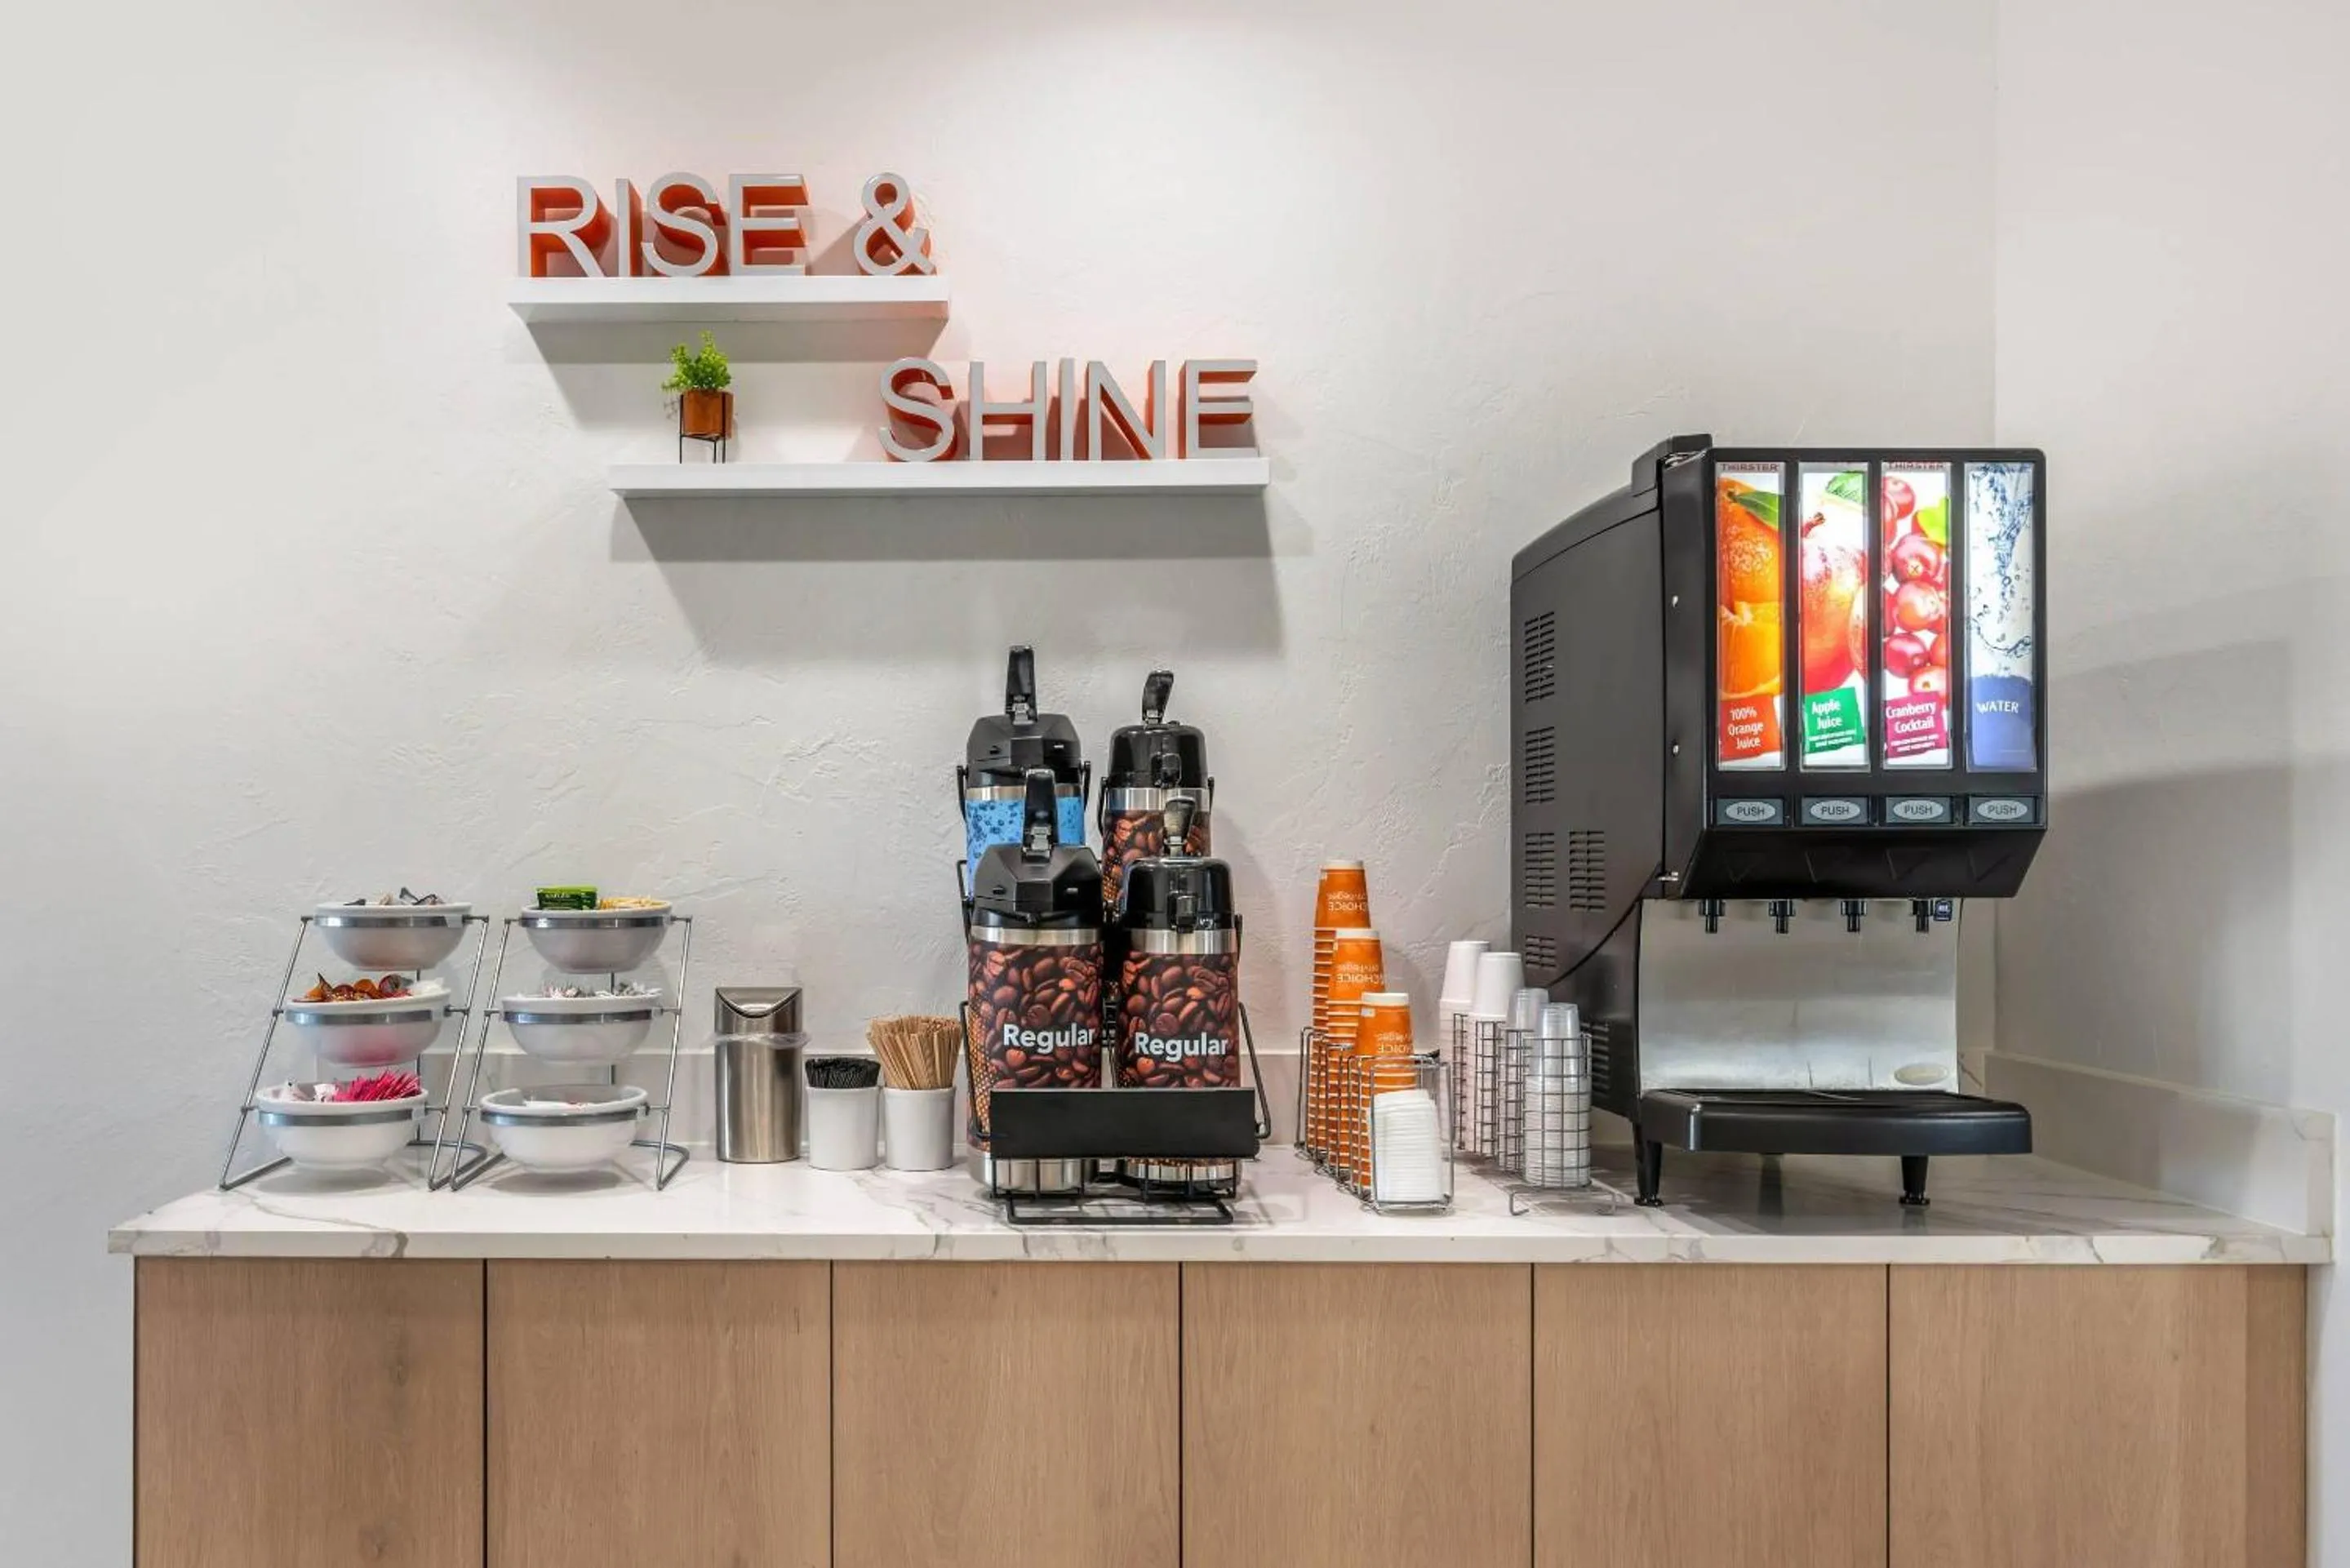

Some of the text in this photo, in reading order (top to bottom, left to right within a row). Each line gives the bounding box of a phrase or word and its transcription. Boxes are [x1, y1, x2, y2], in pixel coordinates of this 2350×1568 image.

[517, 172, 939, 278] RISE &
[878, 357, 1259, 462] SHINE
[1729, 706, 1758, 722] 100%
[1811, 698, 1841, 716] Apple
[1886, 701, 1936, 719] Cranberry
[1976, 700, 2019, 714] WATER
[1727, 722, 1764, 737] Orange
[1816, 715, 1843, 731] Juice
[1894, 715, 1935, 734] Cocktail
[1736, 736, 1761, 750] Juice
[1737, 806, 1765, 816] PUSH
[1821, 805, 1850, 815] PUSH
[1904, 805, 1933, 815] PUSH
[1987, 804, 2018, 815] PUSH
[1002, 1023, 1095, 1055] Regular
[1134, 1032, 1228, 1063] Regular
